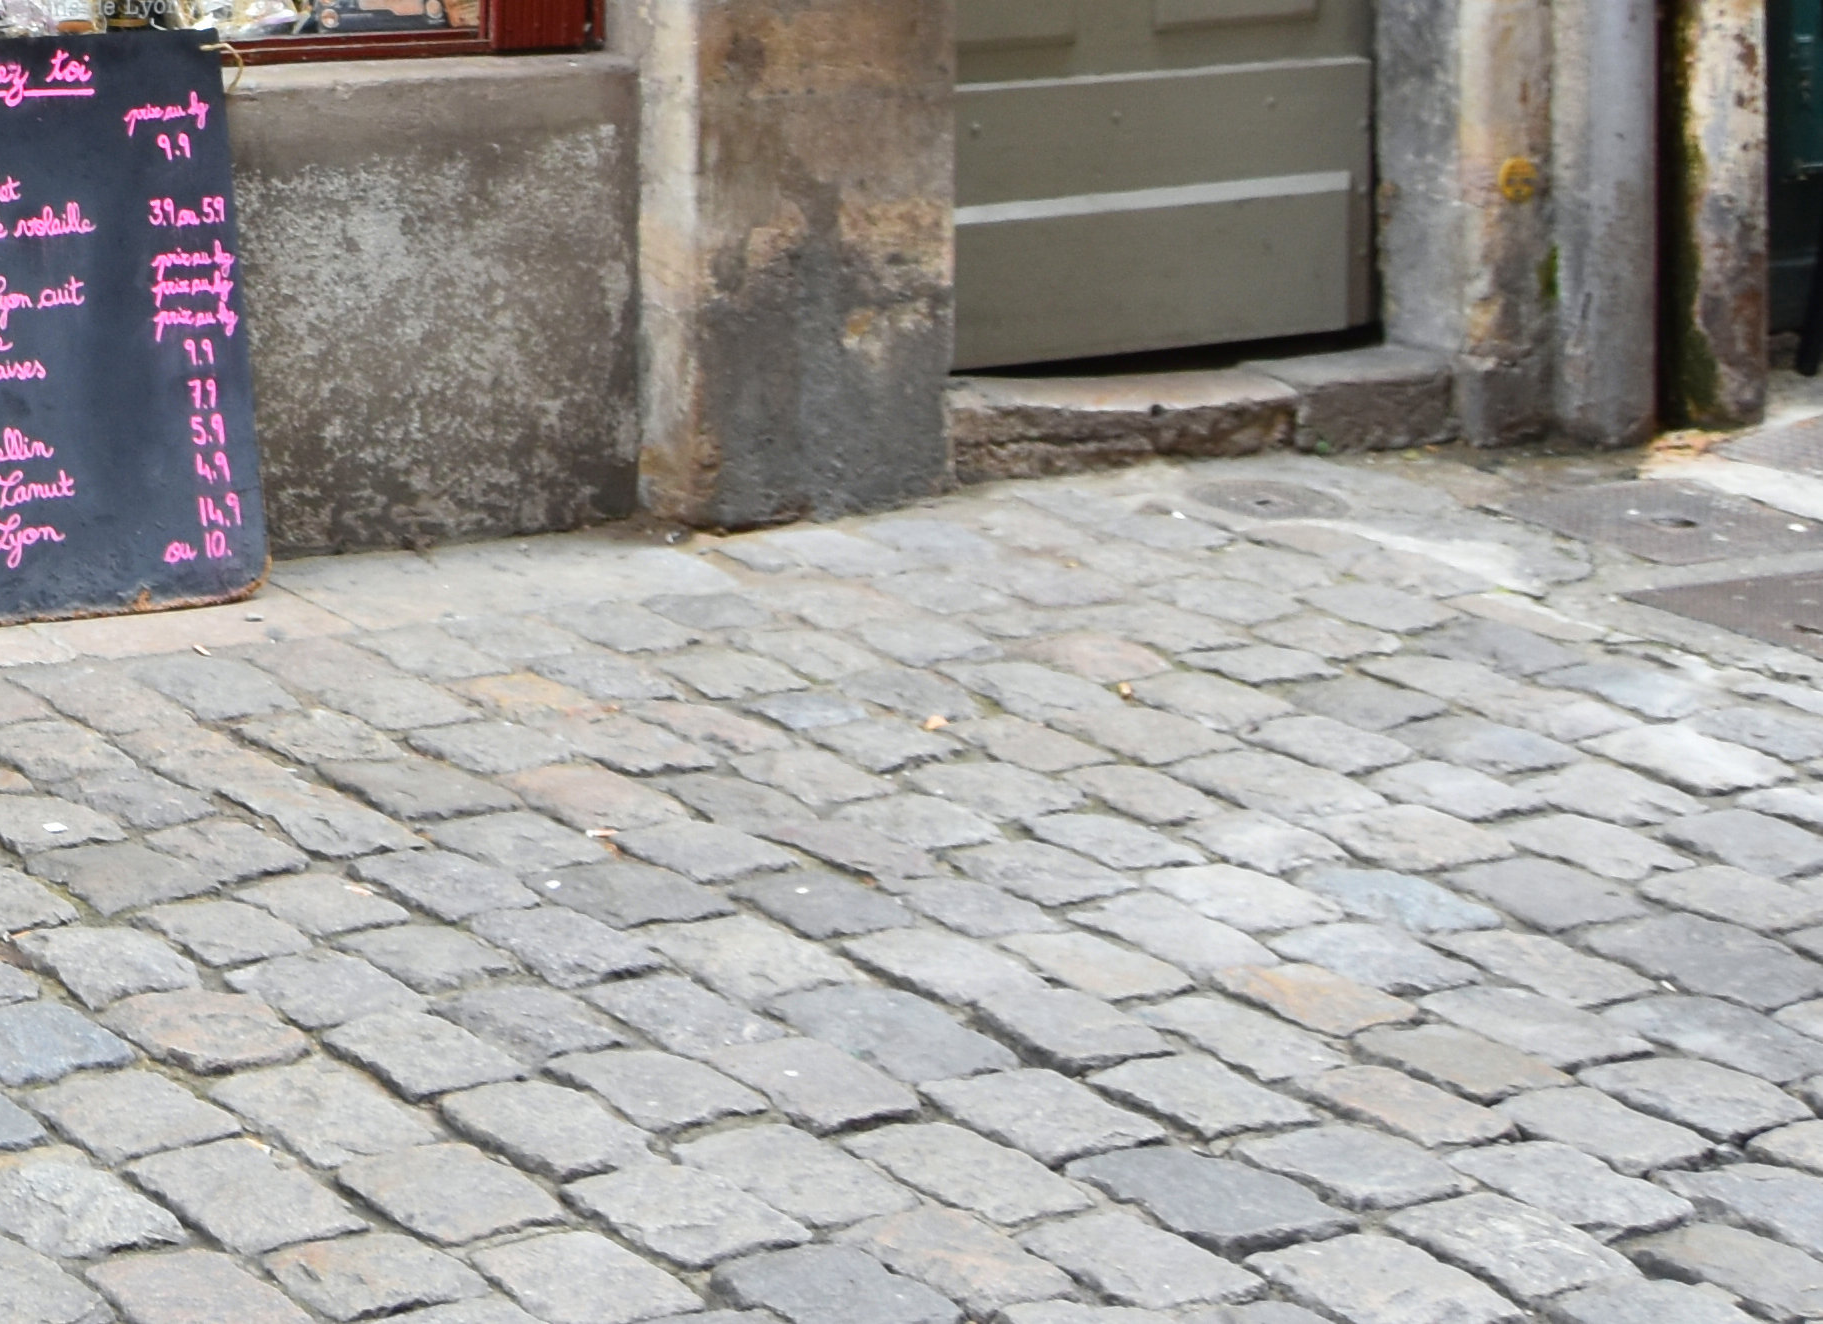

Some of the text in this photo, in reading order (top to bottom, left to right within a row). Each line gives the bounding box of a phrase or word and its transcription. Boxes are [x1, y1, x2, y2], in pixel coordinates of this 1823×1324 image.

[45, 49, 93, 82] toi
[157, 133, 192, 160] 9.9
[183, 337, 215, 366] 9.9
[187, 377, 217, 409] 7.9
[190, 412, 226, 445] 5.9
[195, 451, 231, 484] 4.9
[198, 492, 242, 526] 14.9
[163, 540, 197, 564] ou
